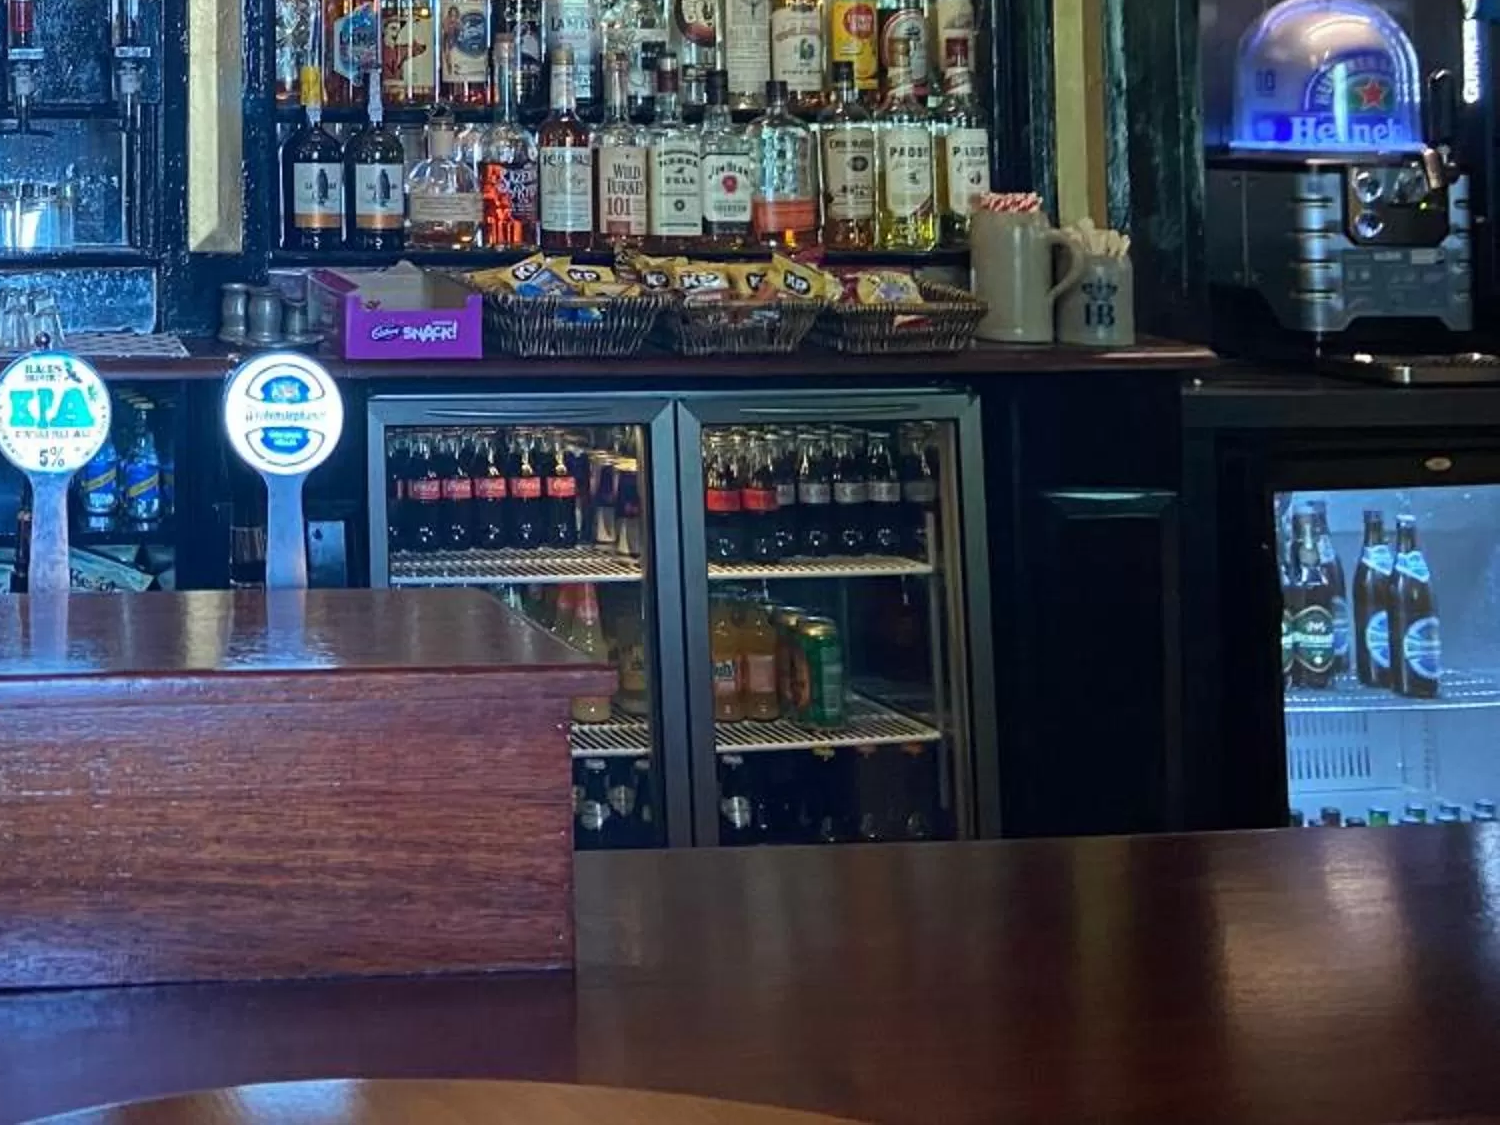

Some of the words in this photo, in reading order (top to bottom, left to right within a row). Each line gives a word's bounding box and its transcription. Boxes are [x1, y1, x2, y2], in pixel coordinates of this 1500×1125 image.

[612, 162, 641, 179] WILD
[606, 196, 632, 216] 101
[9, 388, 96, 429] KPA
[38, 446, 66, 468] 5%
